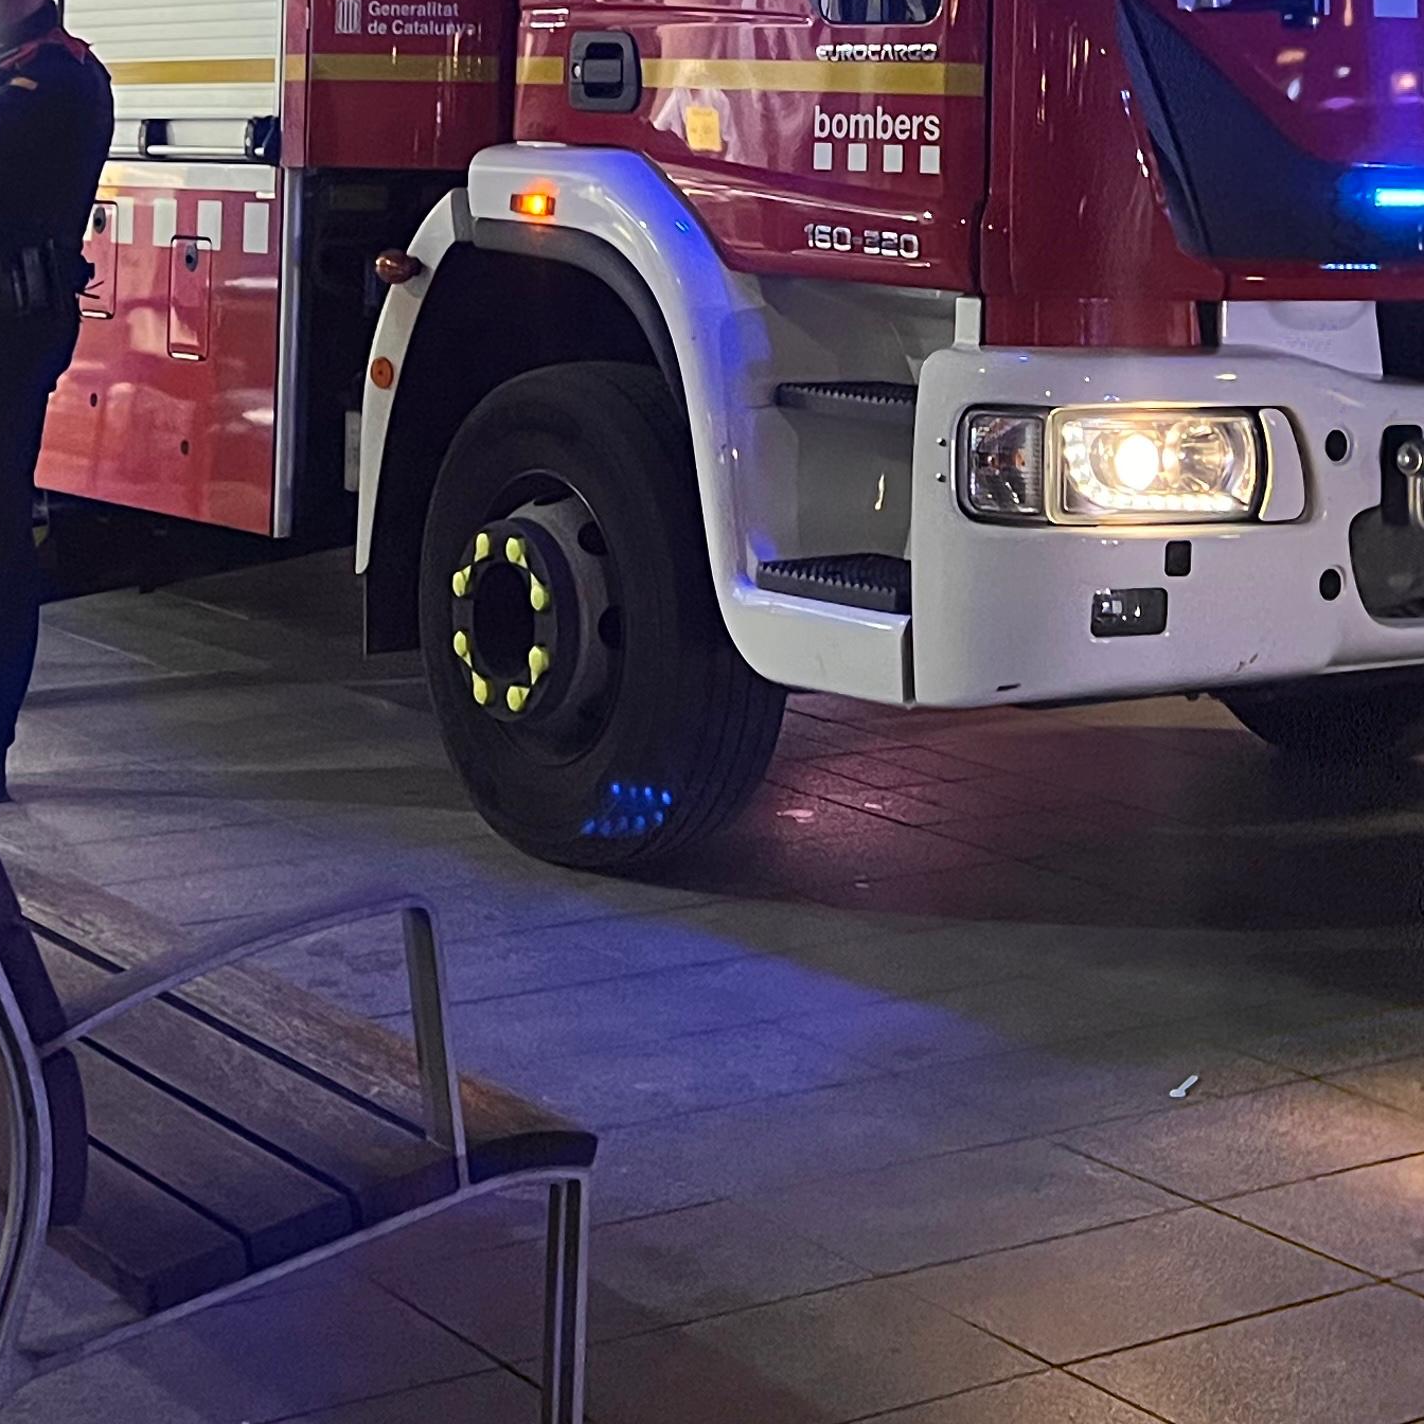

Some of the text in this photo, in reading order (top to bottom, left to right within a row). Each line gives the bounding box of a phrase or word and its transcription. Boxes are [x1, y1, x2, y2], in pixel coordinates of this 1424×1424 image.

[368, 1, 459, 16] Generalitat
[368, 19, 475, 38] de Catalunya
[815, 43, 938, 62] EUROCARGO
[814, 105, 940, 141] bombers
